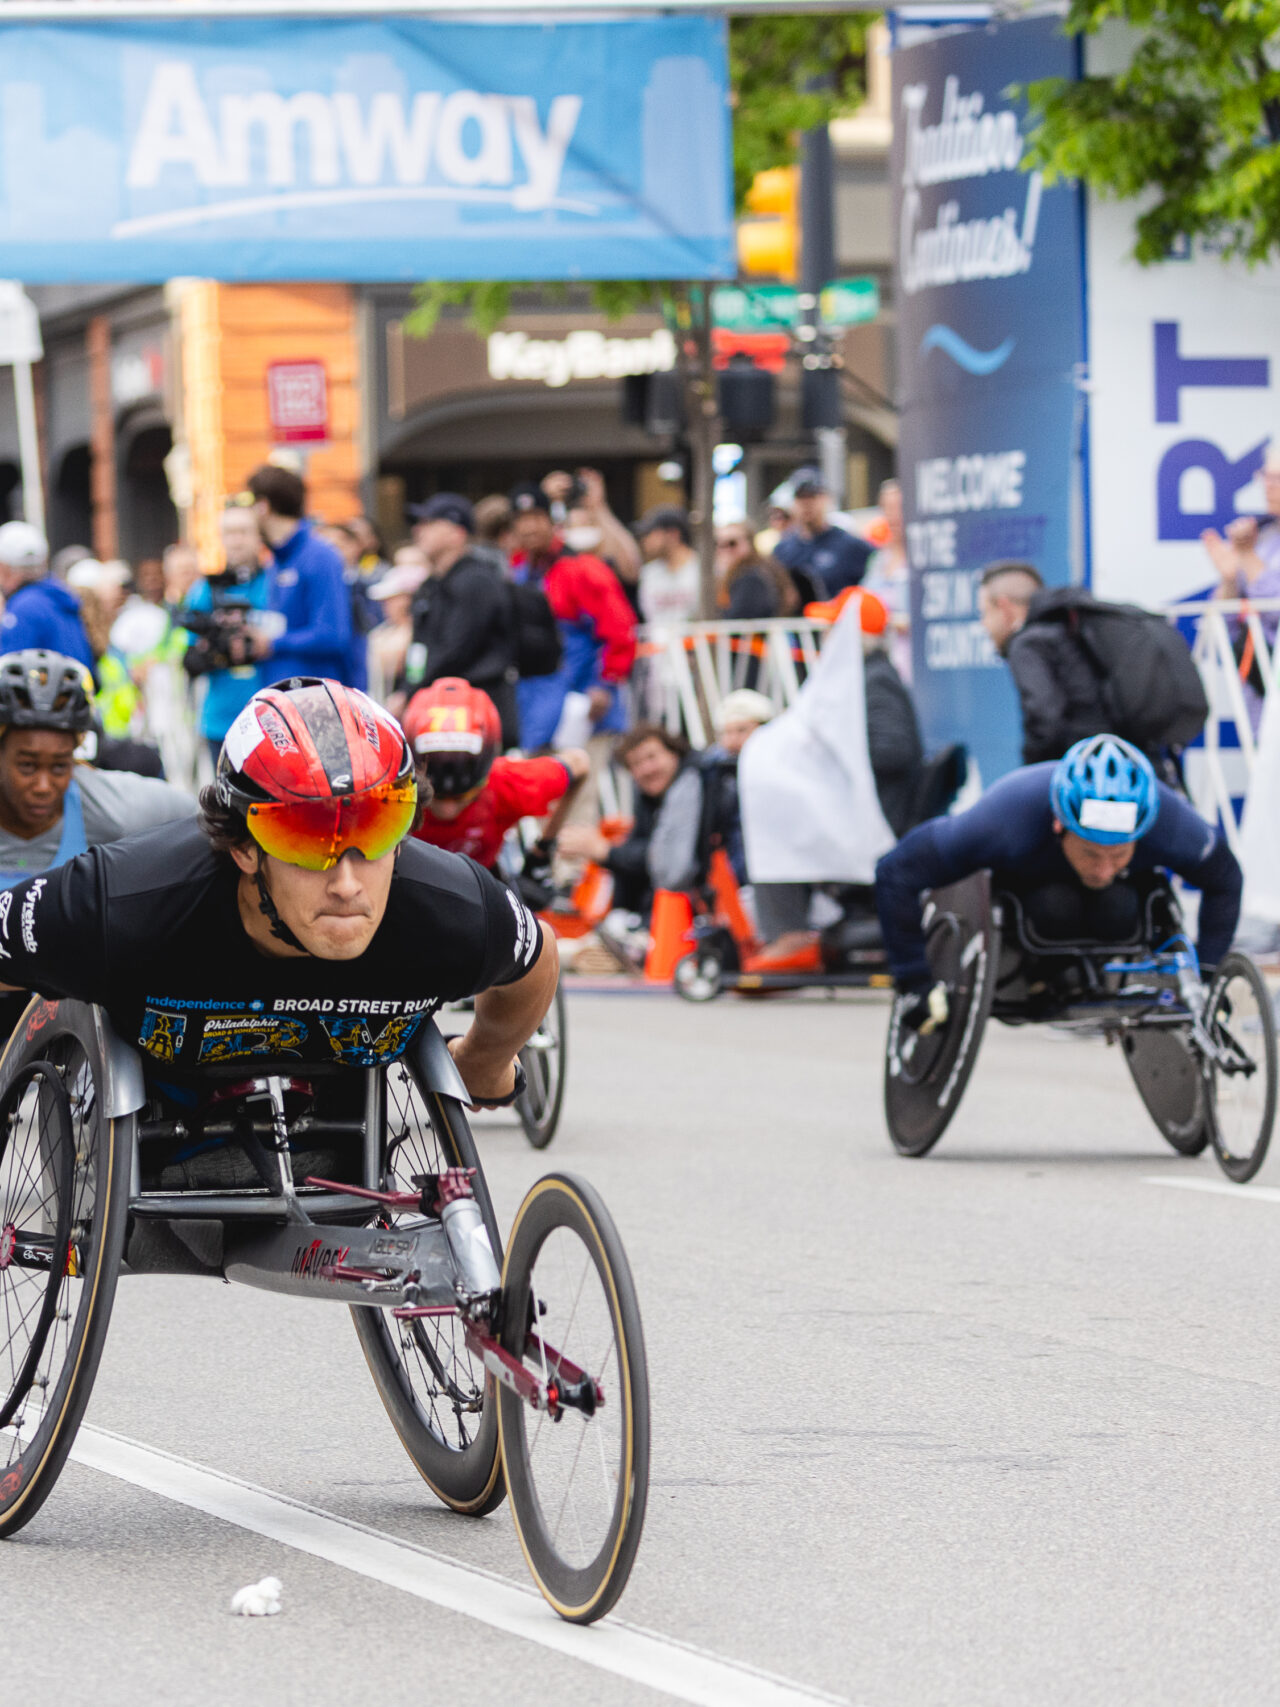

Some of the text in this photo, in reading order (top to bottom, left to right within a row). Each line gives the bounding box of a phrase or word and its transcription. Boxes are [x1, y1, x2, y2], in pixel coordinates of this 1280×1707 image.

[126, 61, 584, 212] Amway
[902, 74, 1024, 188] Tradition
[487, 329, 676, 388] KeyBank
[915, 450, 1027, 516] WELCOME
[428, 706, 468, 732] 71
[146, 995, 245, 1010] Independence
[273, 996, 439, 1014] BROAD STREET RUN
[203, 1018, 280, 1032] Philadelphia
